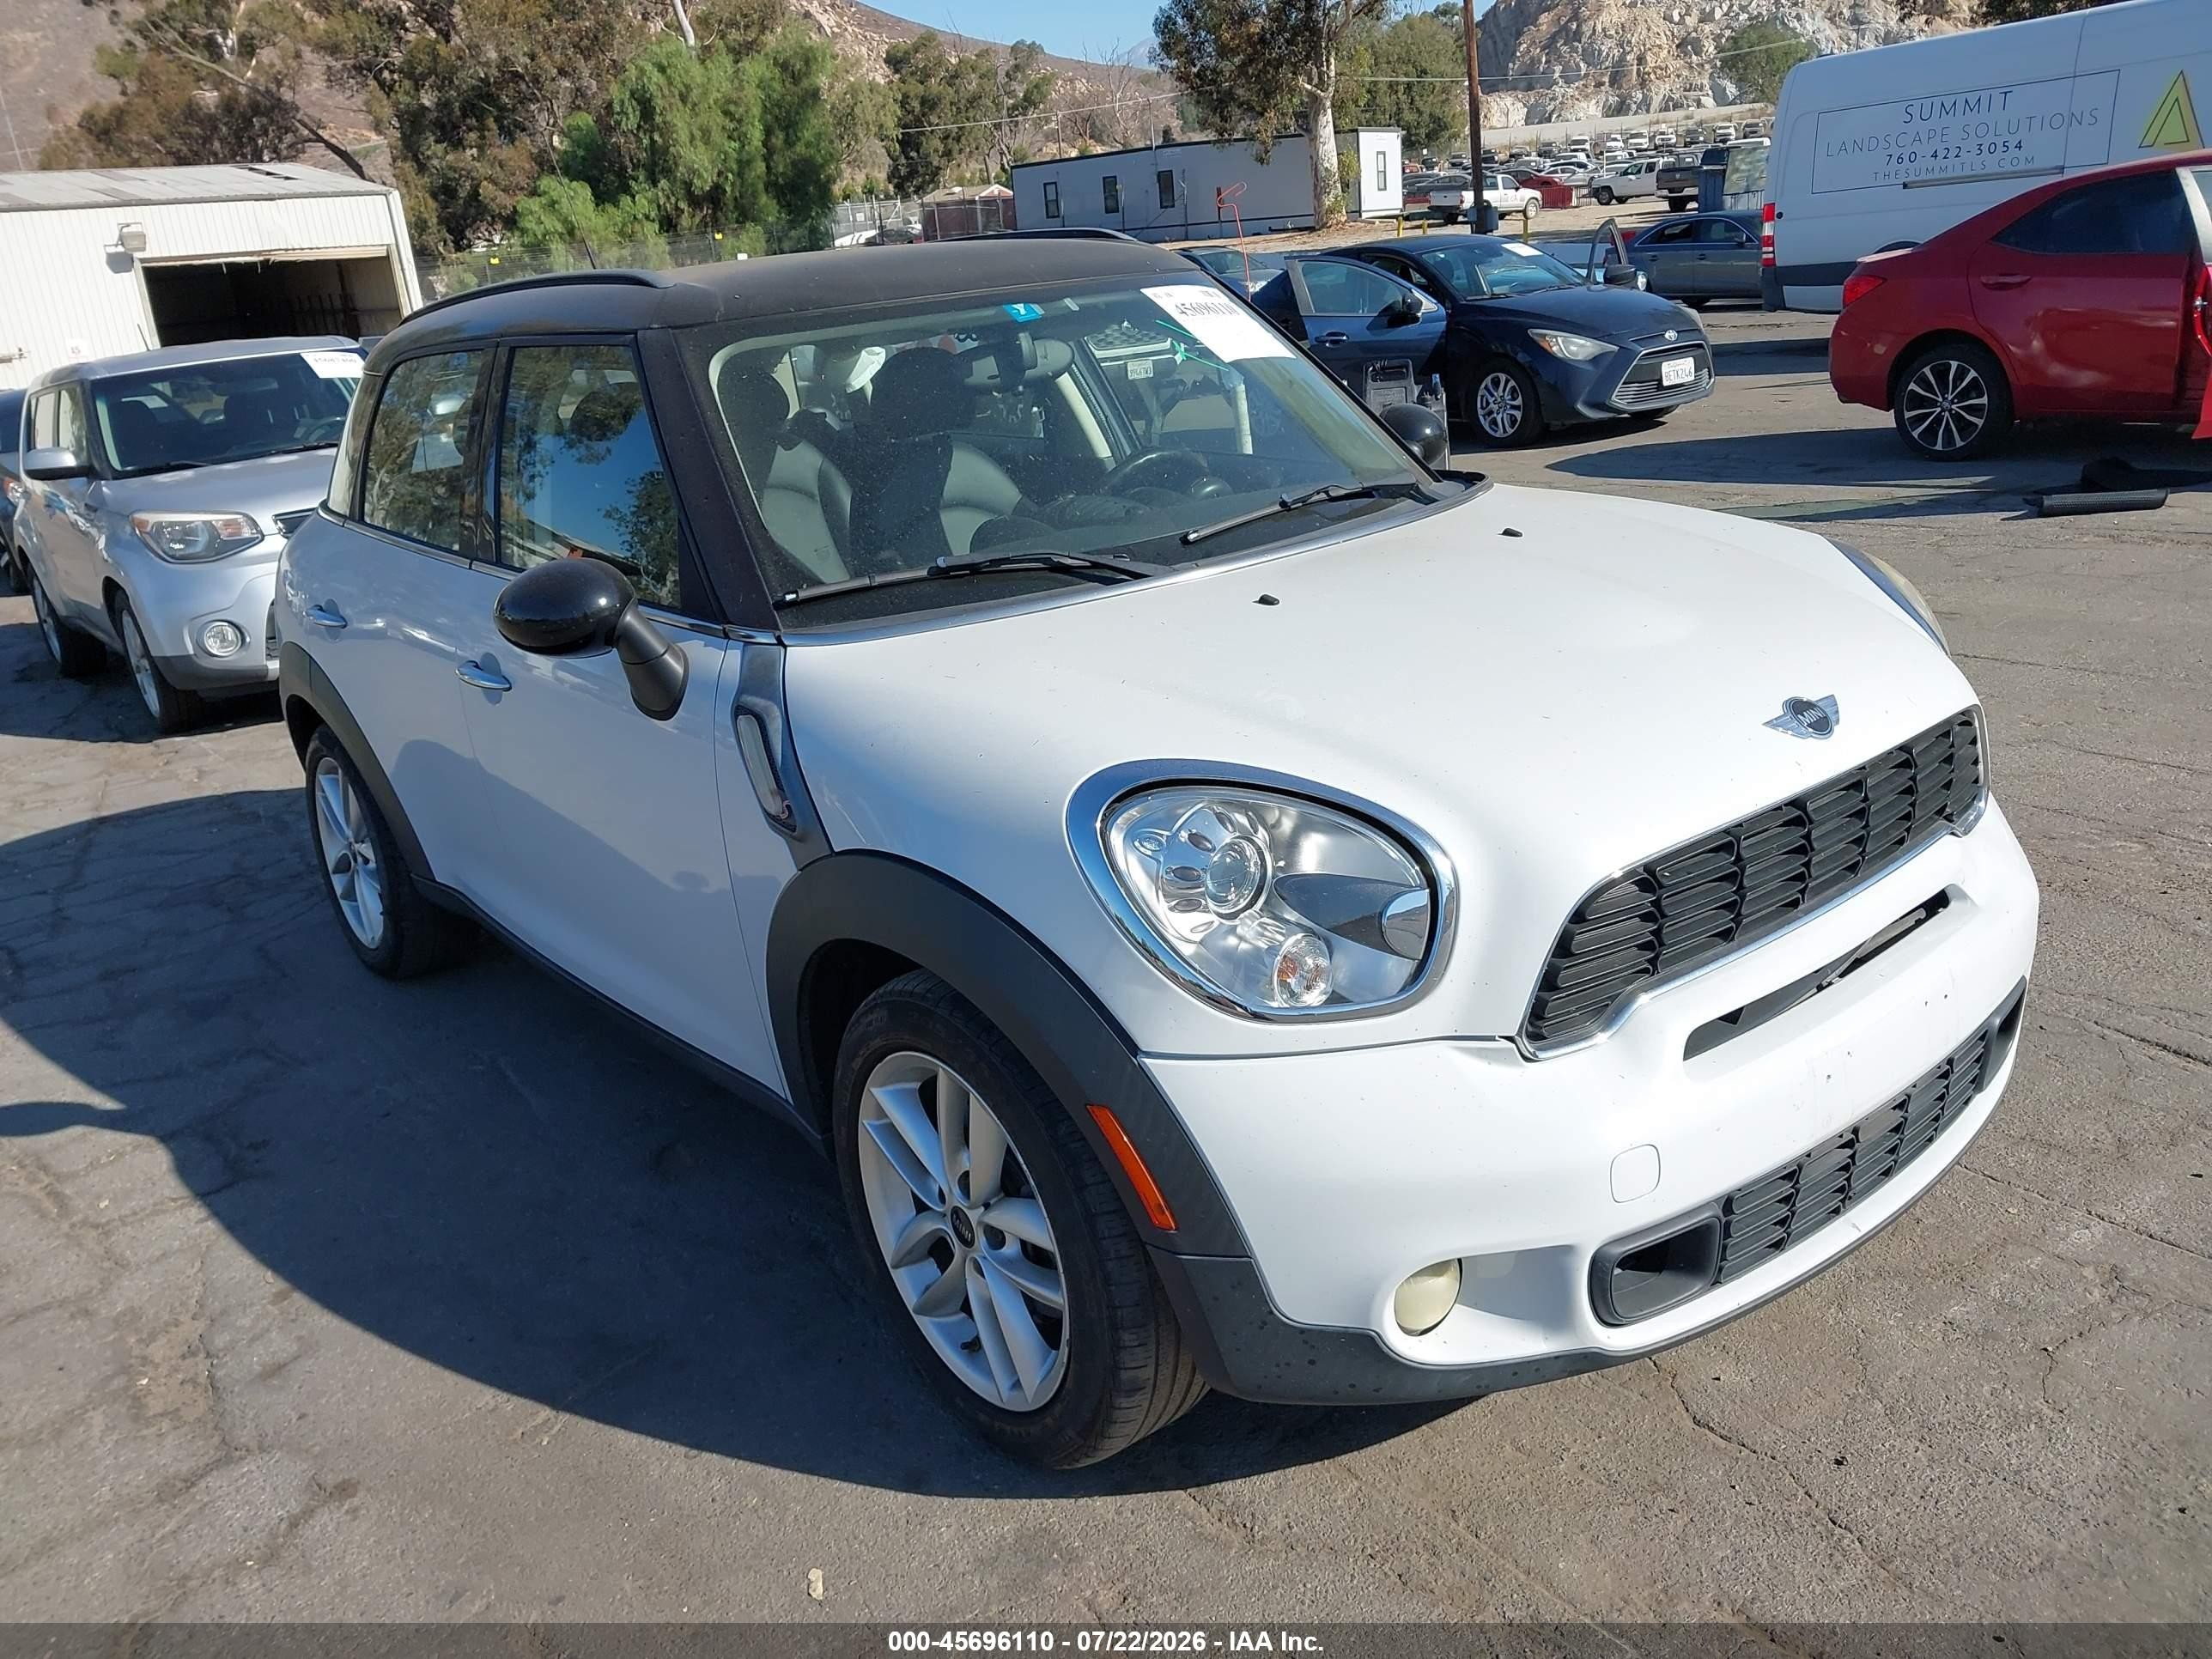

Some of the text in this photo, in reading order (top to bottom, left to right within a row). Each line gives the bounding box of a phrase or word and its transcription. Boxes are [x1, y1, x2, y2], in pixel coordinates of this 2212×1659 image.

[1903, 90, 2013, 124] SUMMIT
[1826, 107, 2099, 157] LANDSCAPE SOLUTIONS
[1885, 139, 2024, 167] 760-422-3054
[1796, 707, 1826, 726] MINI
